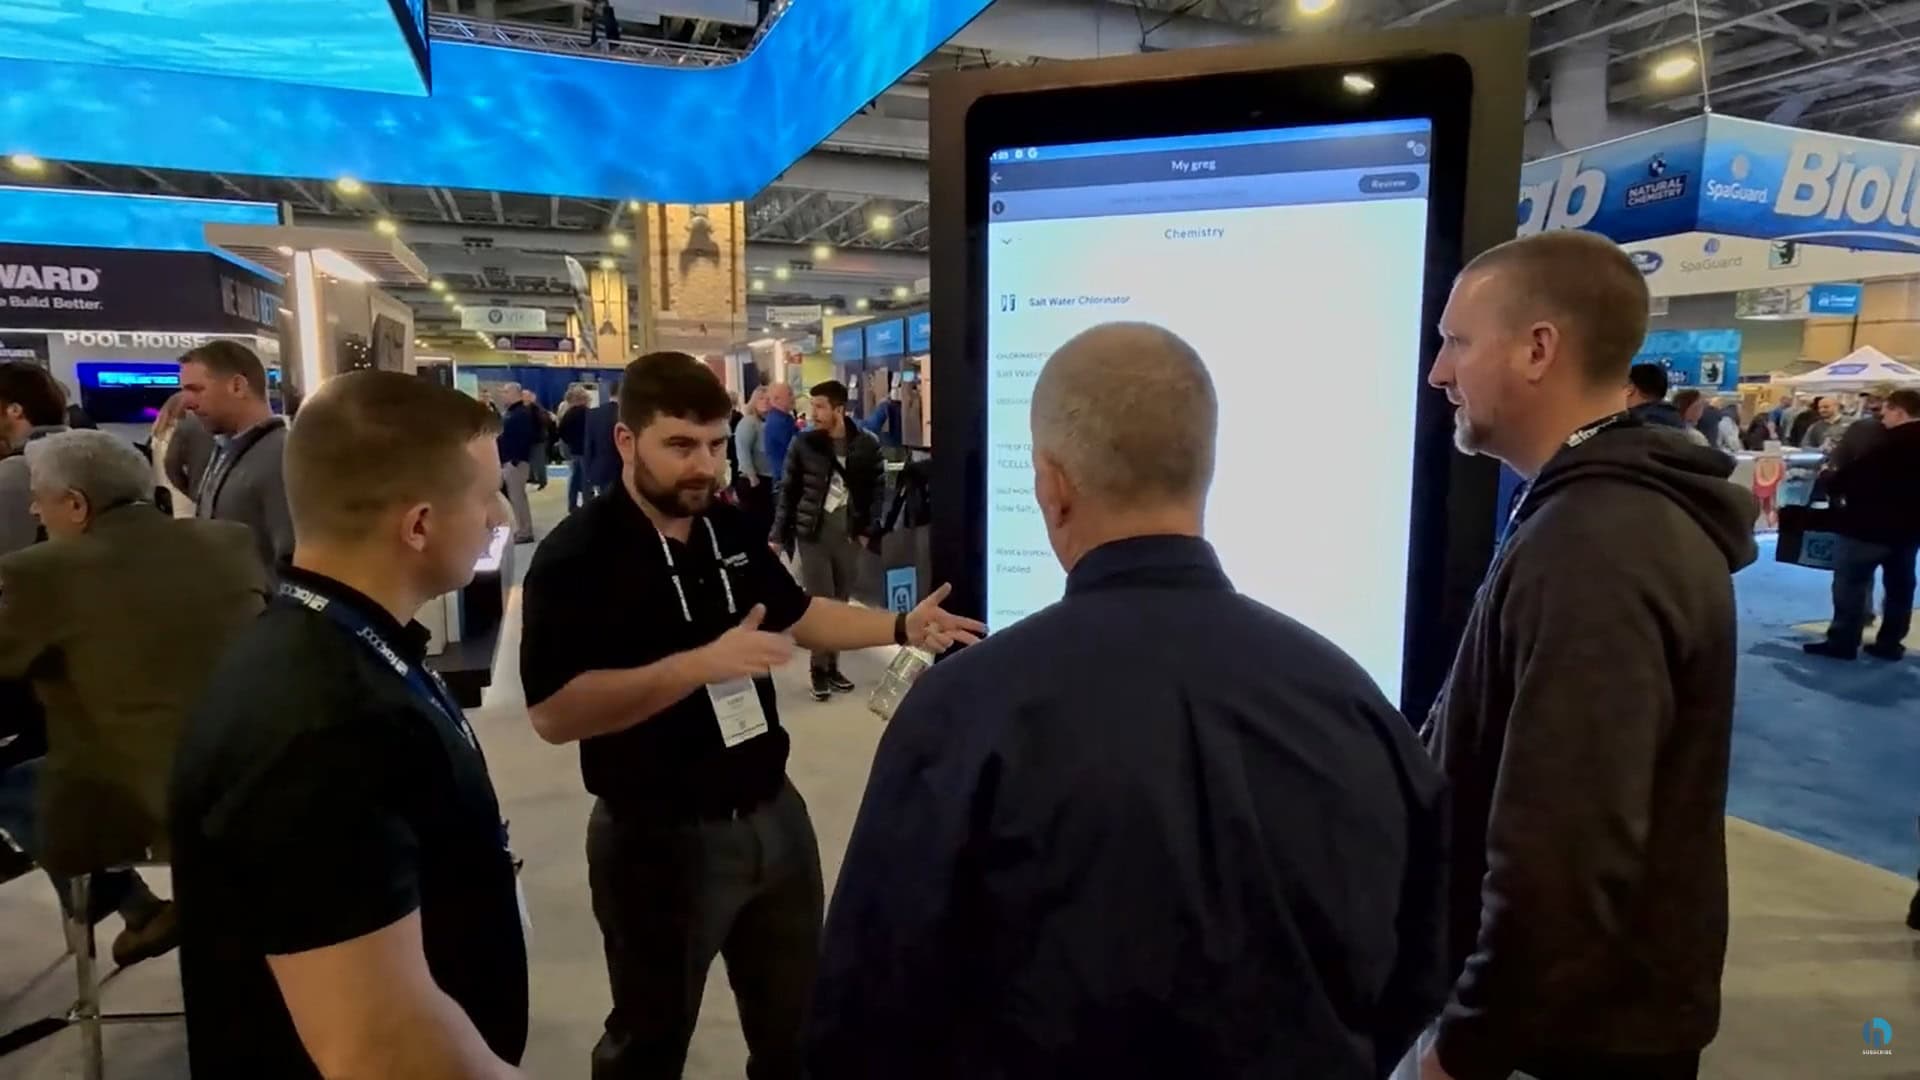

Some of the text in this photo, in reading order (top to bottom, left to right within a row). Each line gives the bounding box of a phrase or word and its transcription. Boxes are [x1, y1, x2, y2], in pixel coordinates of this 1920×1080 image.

[1171, 160, 1216, 173] My greg
[1371, 179, 1406, 189] Review
[1628, 178, 1684, 199] NATURAL
[1707, 179, 1769, 204] SpaGuard
[1628, 189, 1683, 207] CHEMISTRY
[1164, 228, 1225, 240] Chemistry
[1680, 256, 1742, 273] SpaGuard
[9, 296, 50, 308] Build
[1028, 295, 1131, 307] Salt Water Chlorinator
[63, 330, 208, 348] POOL HOUSE
